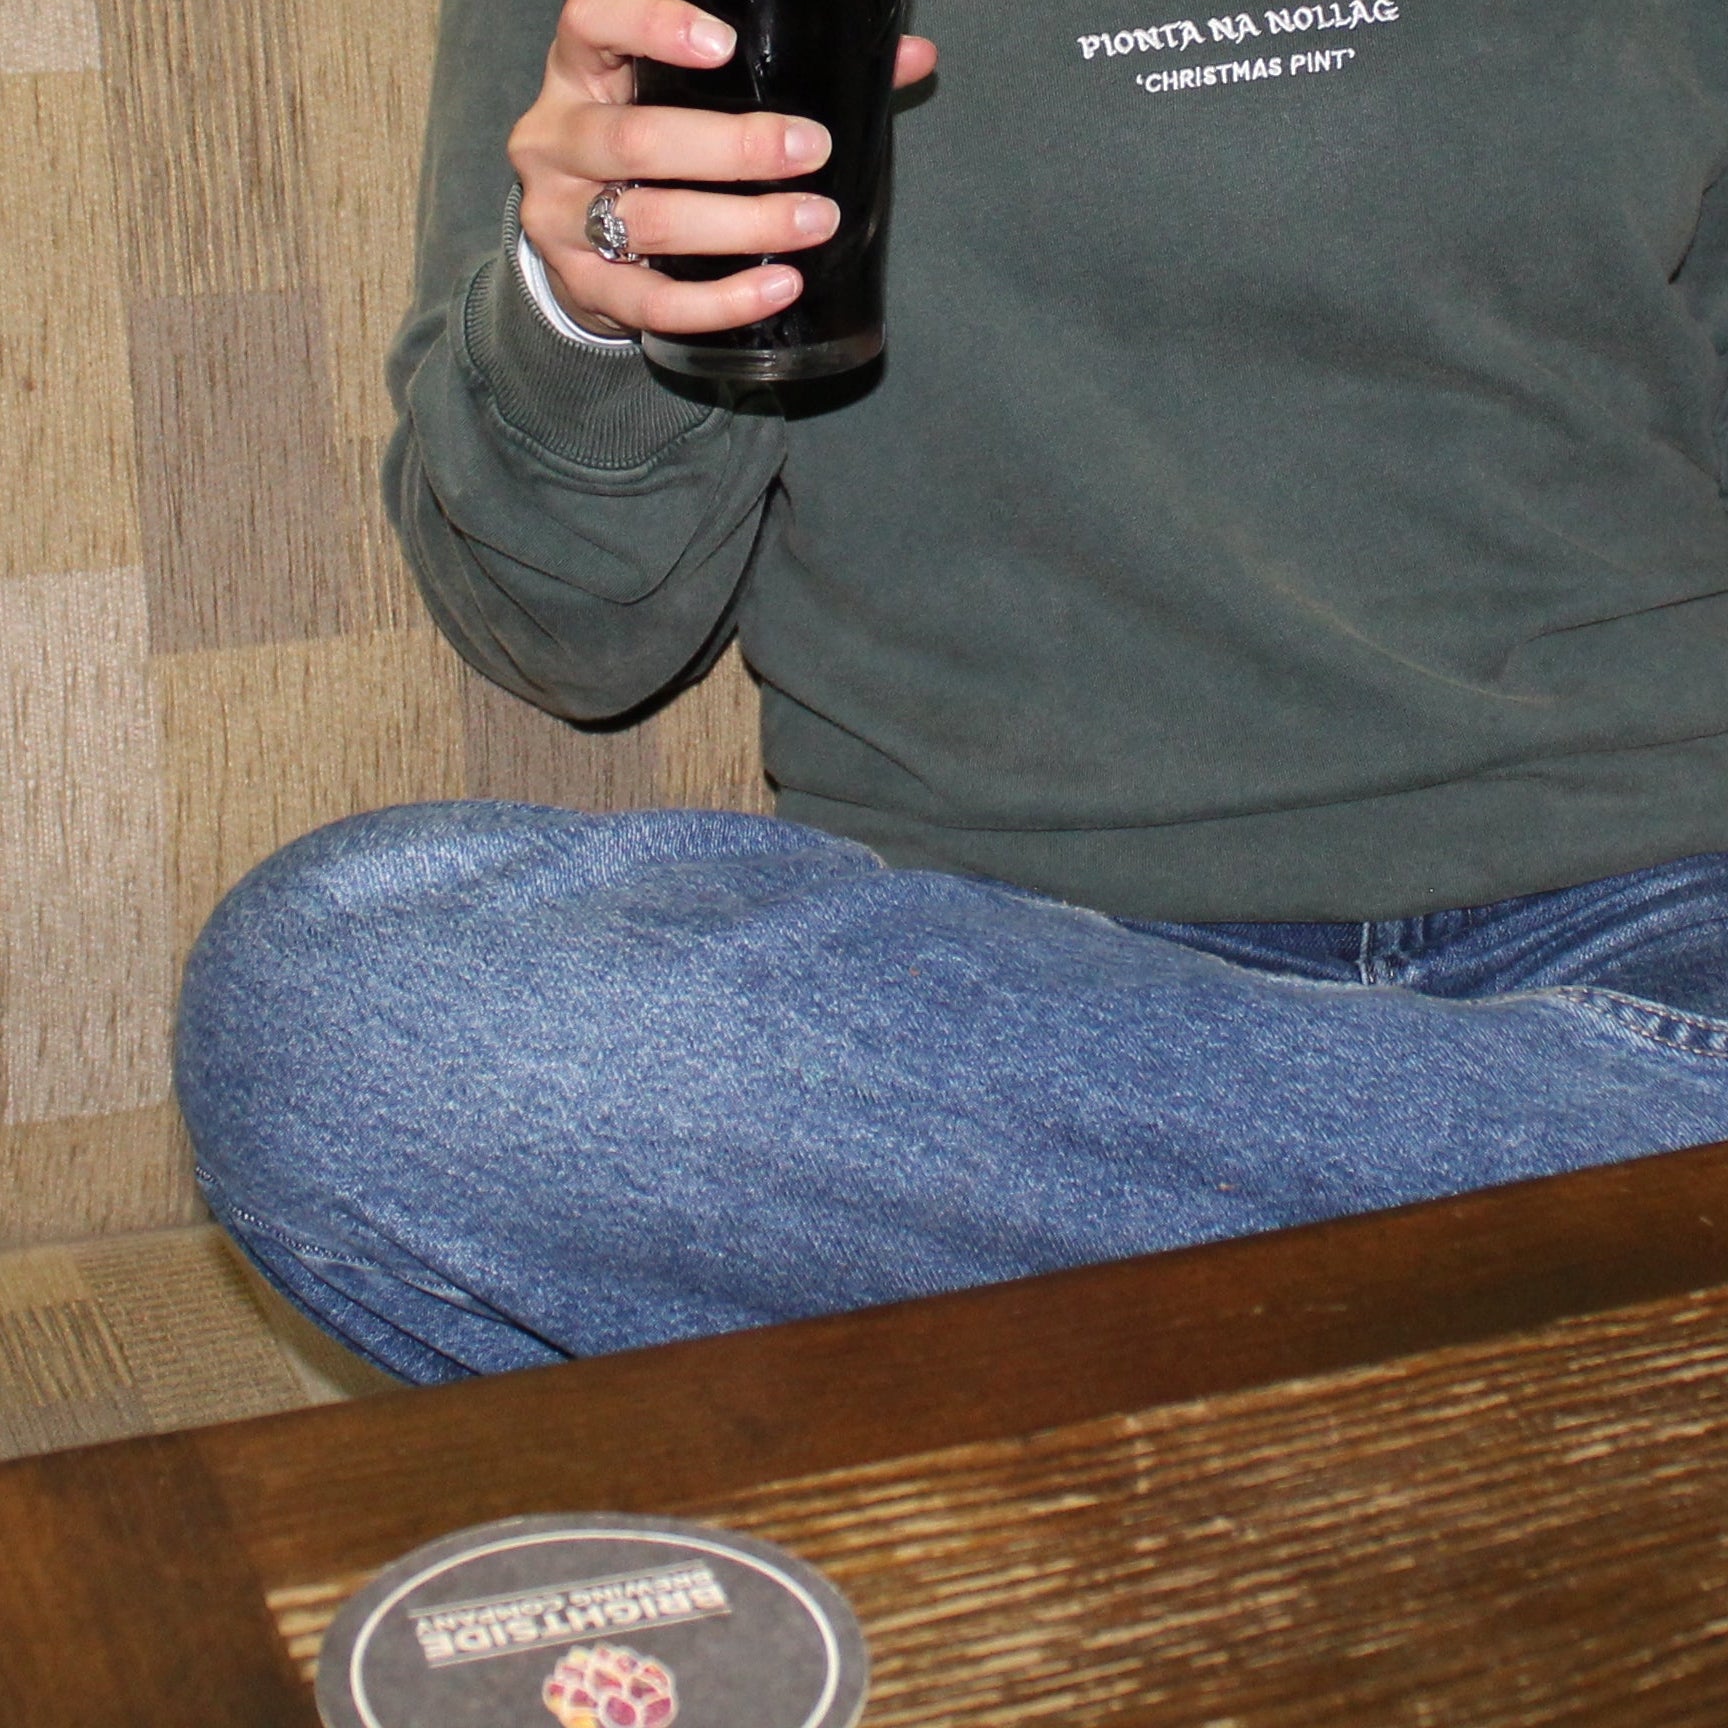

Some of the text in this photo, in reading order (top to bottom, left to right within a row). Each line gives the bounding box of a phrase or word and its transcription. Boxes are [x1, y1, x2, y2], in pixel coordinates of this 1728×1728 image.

[1077, 19, 1206, 60] PIONTA
[1207, 12, 1261, 44] NA
[415, 1567, 714, 1638] BREWING COMPANY
[419, 1583, 728, 1662] BRIGHTSIDE
